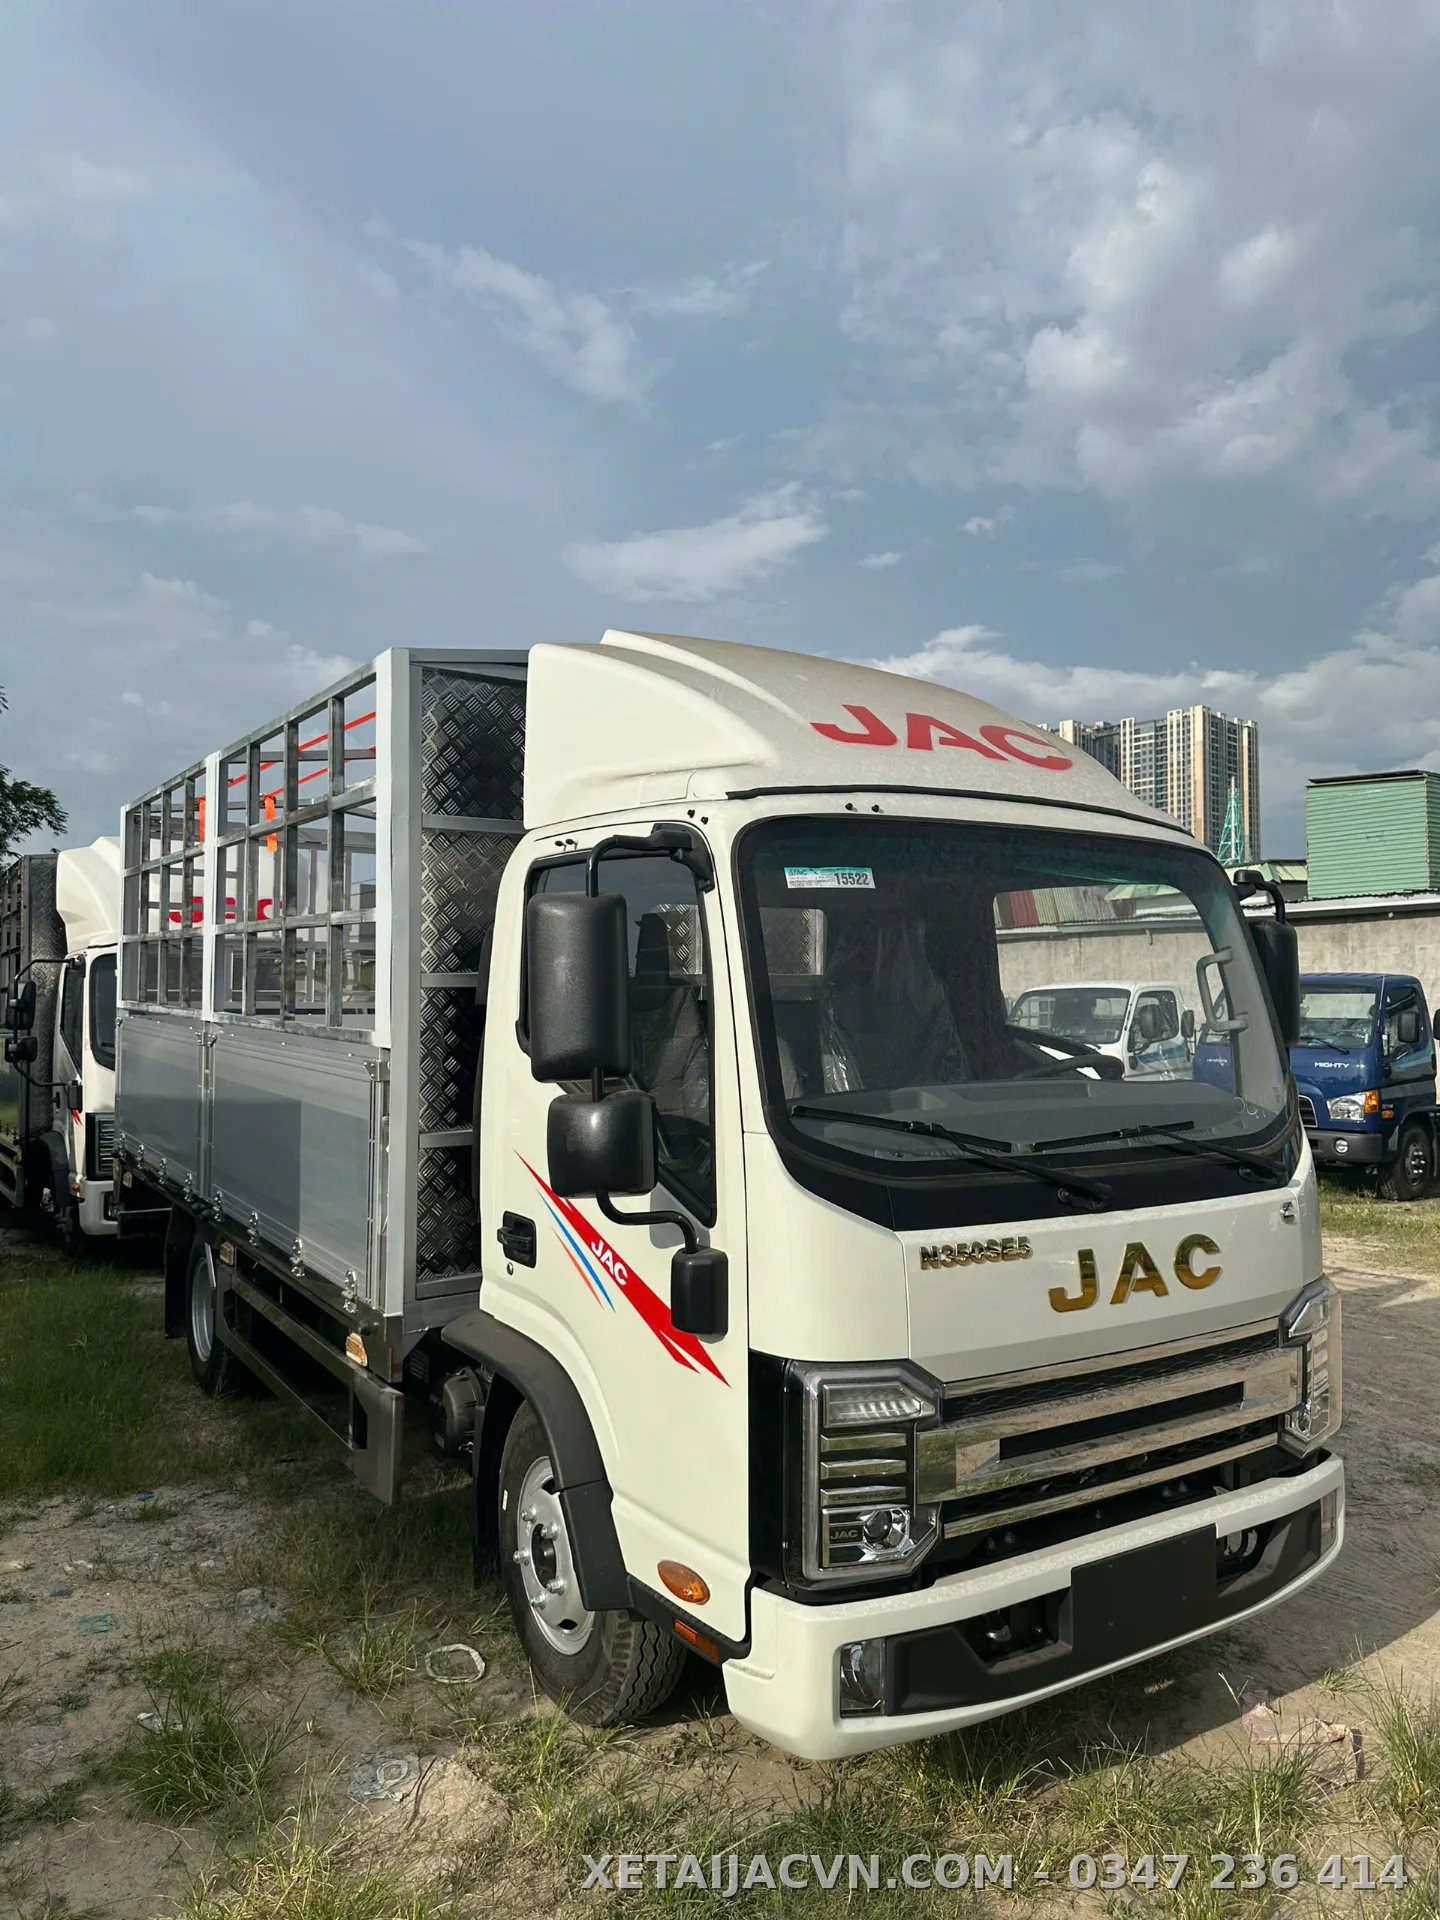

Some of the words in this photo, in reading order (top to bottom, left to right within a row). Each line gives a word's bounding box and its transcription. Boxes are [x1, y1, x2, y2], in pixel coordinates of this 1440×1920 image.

[810, 704, 1072, 770] JAC
[834, 872, 870, 885] 15522
[591, 1240, 628, 1286] JAC
[919, 1236, 1034, 1270] N350SE5
[1048, 1233, 1222, 1313] JAC
[830, 1530, 858, 1539] JAC
